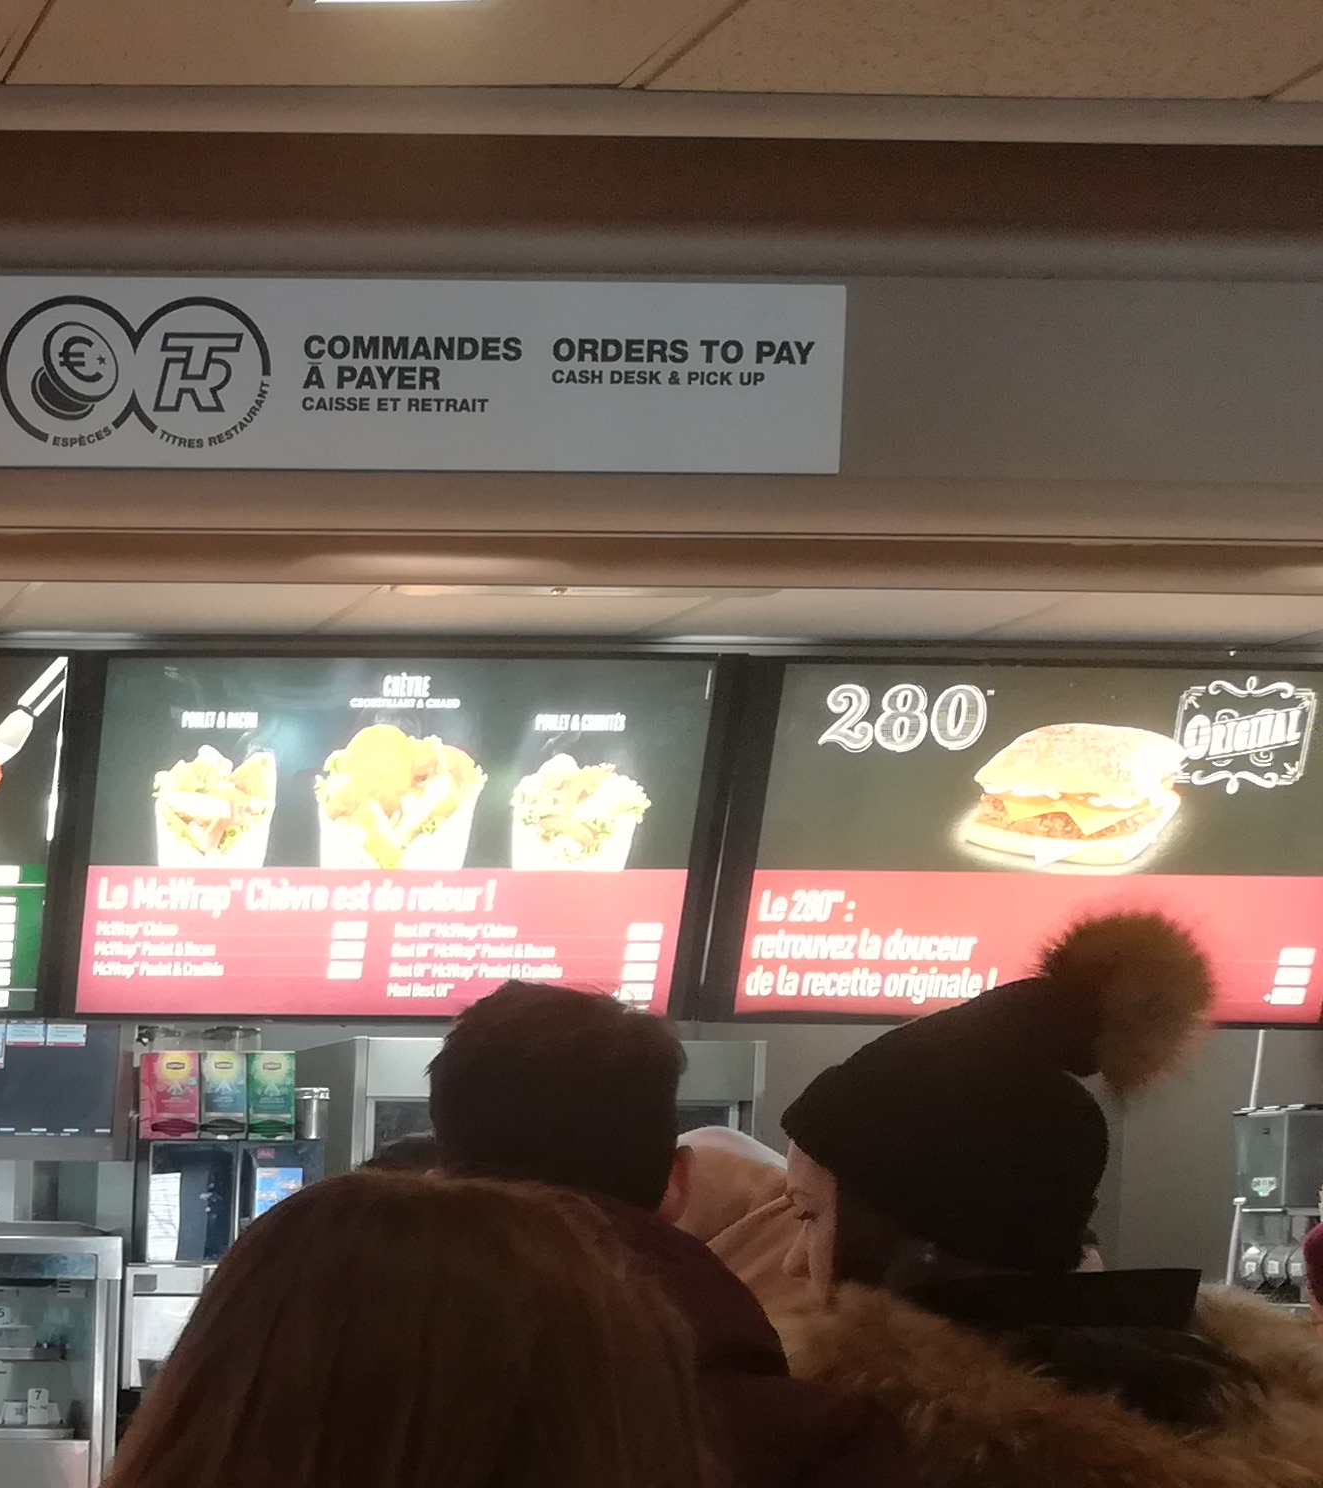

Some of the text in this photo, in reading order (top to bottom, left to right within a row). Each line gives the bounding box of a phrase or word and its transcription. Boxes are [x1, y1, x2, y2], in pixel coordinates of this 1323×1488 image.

[303, 335, 523, 361] COMMANDES
[552, 338, 815, 365] ORDERS TO PAY
[337, 365, 440, 391] PAYER
[551, 369, 766, 387] CASH DESK & PICK UP
[159, 380, 272, 449] TITRES RESTAURANT
[302, 396, 488, 414] CAISSE ET RETRAIT
[52, 425, 113, 448] ESPÈCES
[759, 889, 788, 922] Le
[752, 930, 977, 961] retrouvez la douceur
[746, 965, 773, 996] de
[776, 966, 799, 996] la
[801, 966, 882, 998] recette
[885, 967, 982, 1003] originale
